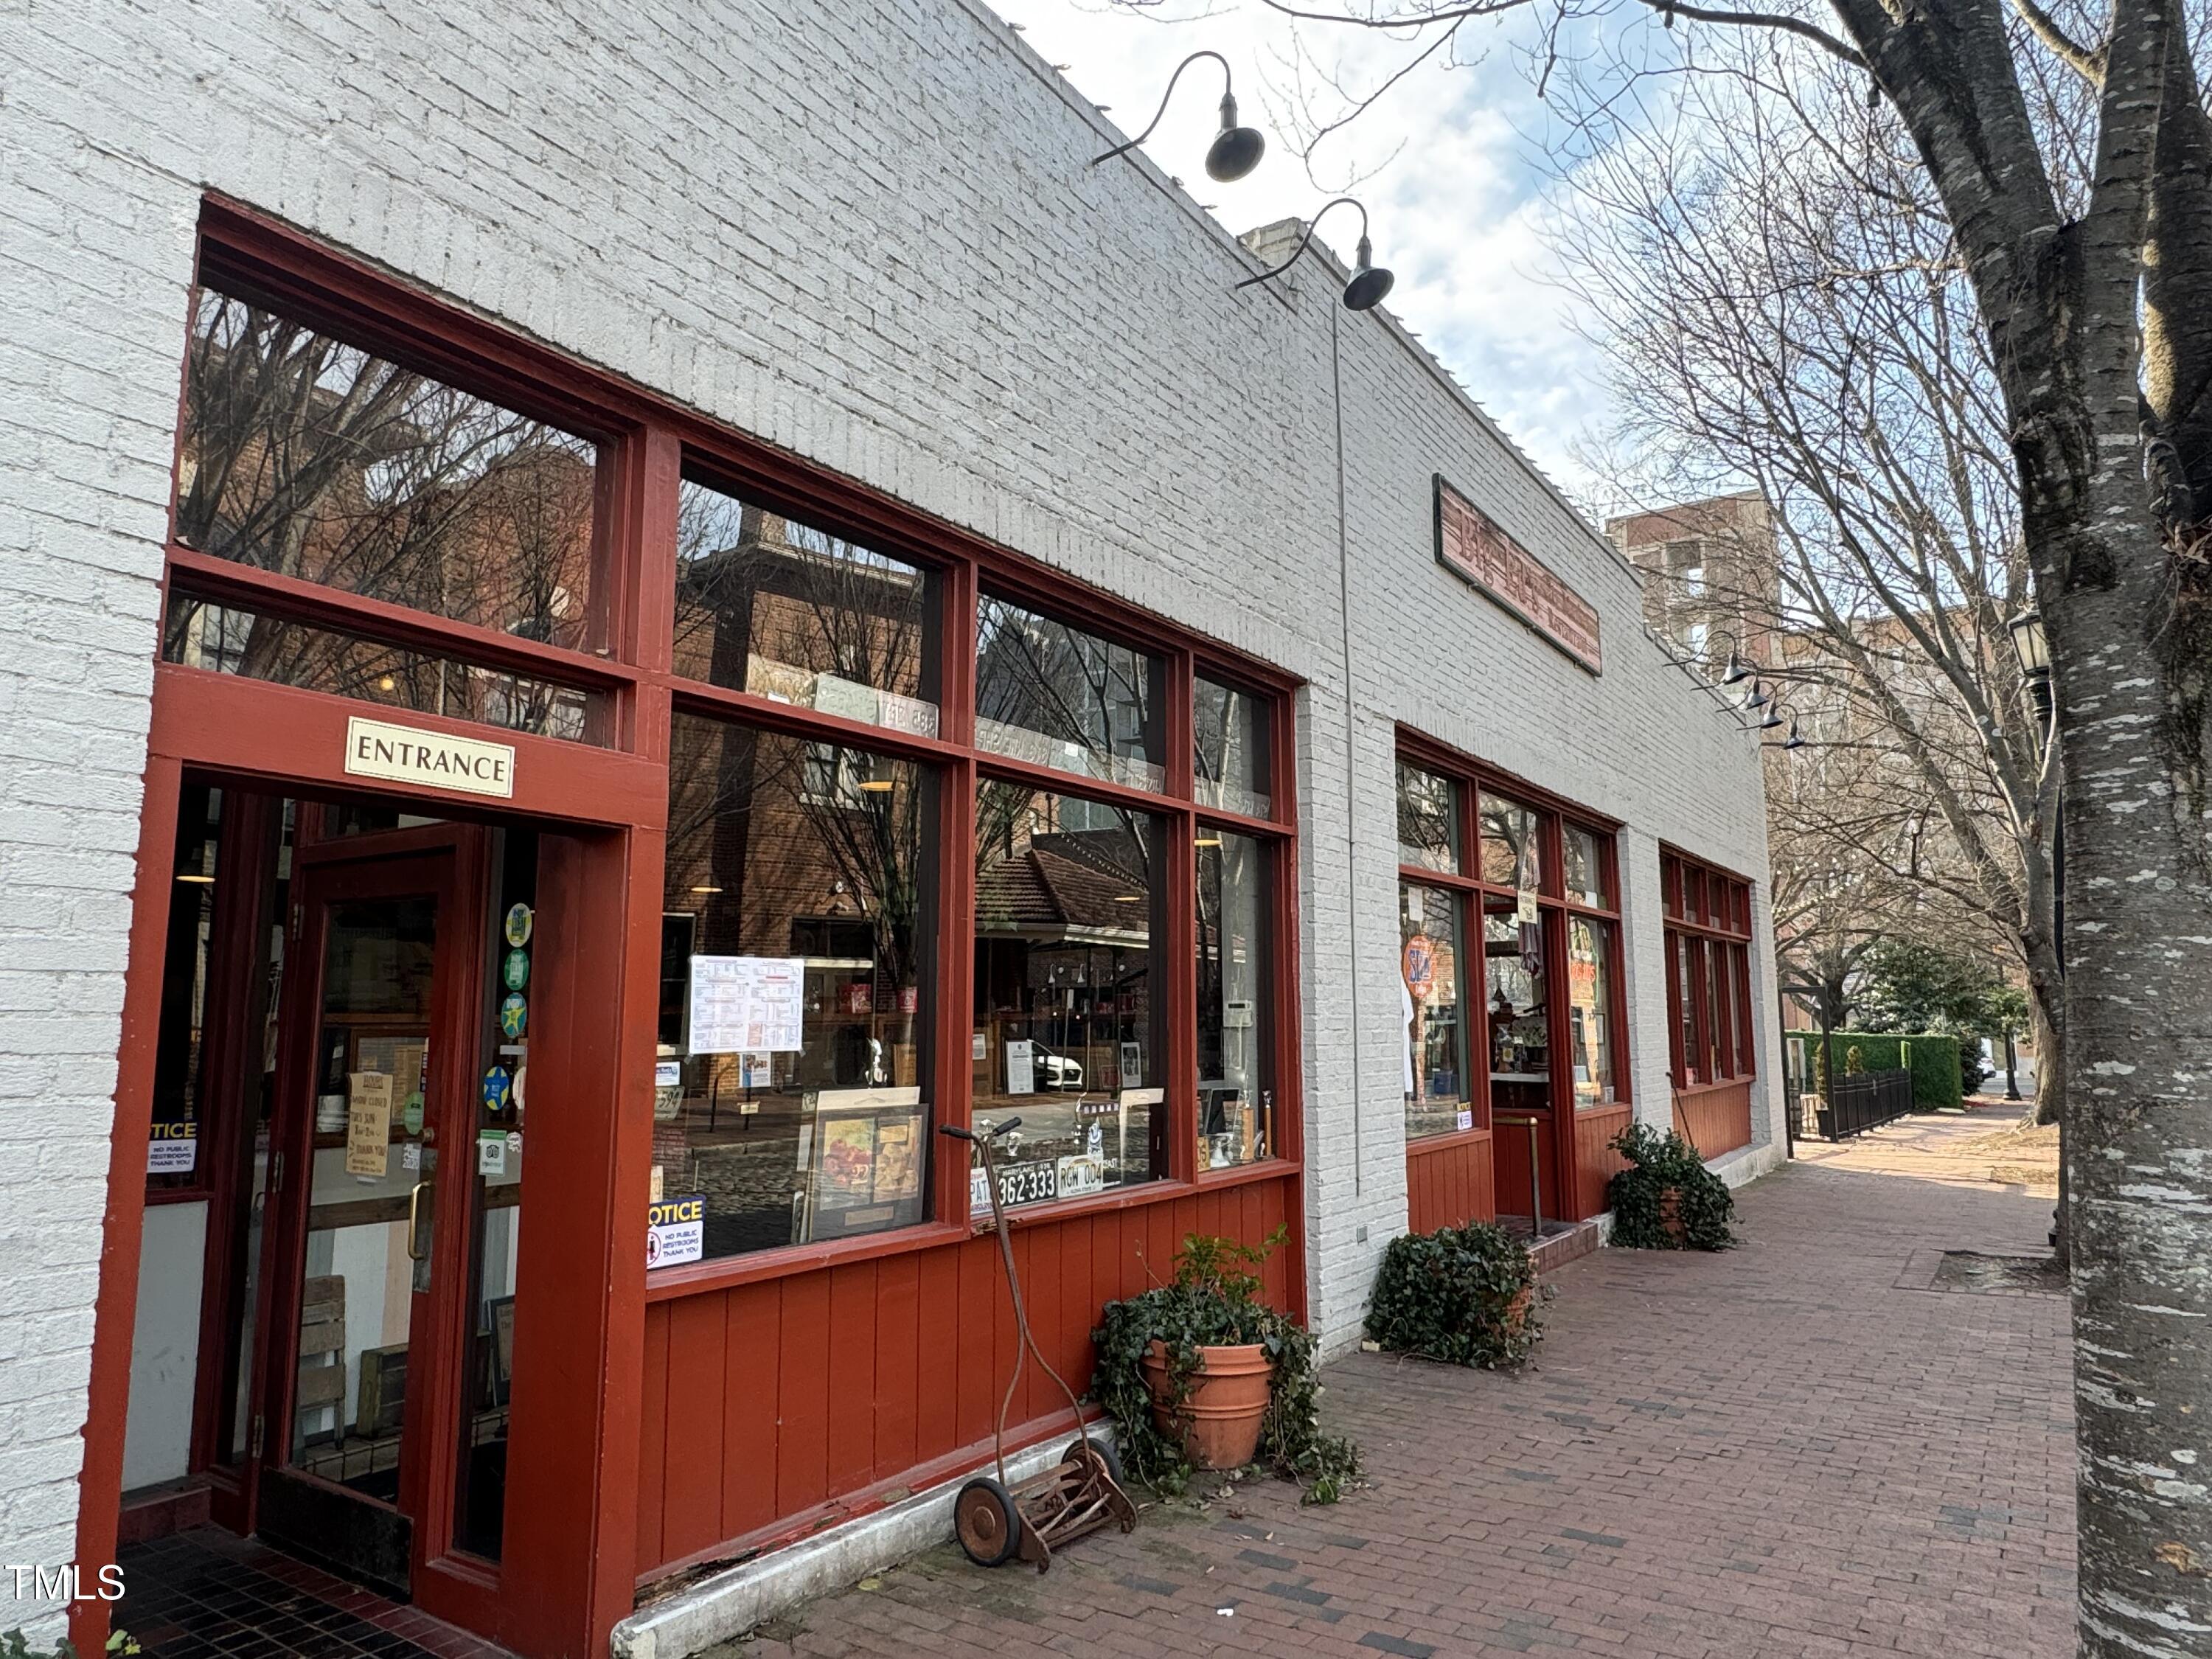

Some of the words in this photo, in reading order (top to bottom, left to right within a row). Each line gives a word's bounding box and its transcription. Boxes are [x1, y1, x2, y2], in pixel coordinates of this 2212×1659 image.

[358, 735, 505, 782] ENTRANCE
[150, 1122, 198, 1138] TICE
[1002, 1166, 1035, 1177] MARYLAND
[649, 1200, 703, 1225] OTICE
[676, 1230, 698, 1239] PUBLIC
[662, 1238, 699, 1249] RESTROOMS
[663, 1249, 684, 1257] THANK
[686, 1246, 699, 1254] YOU
